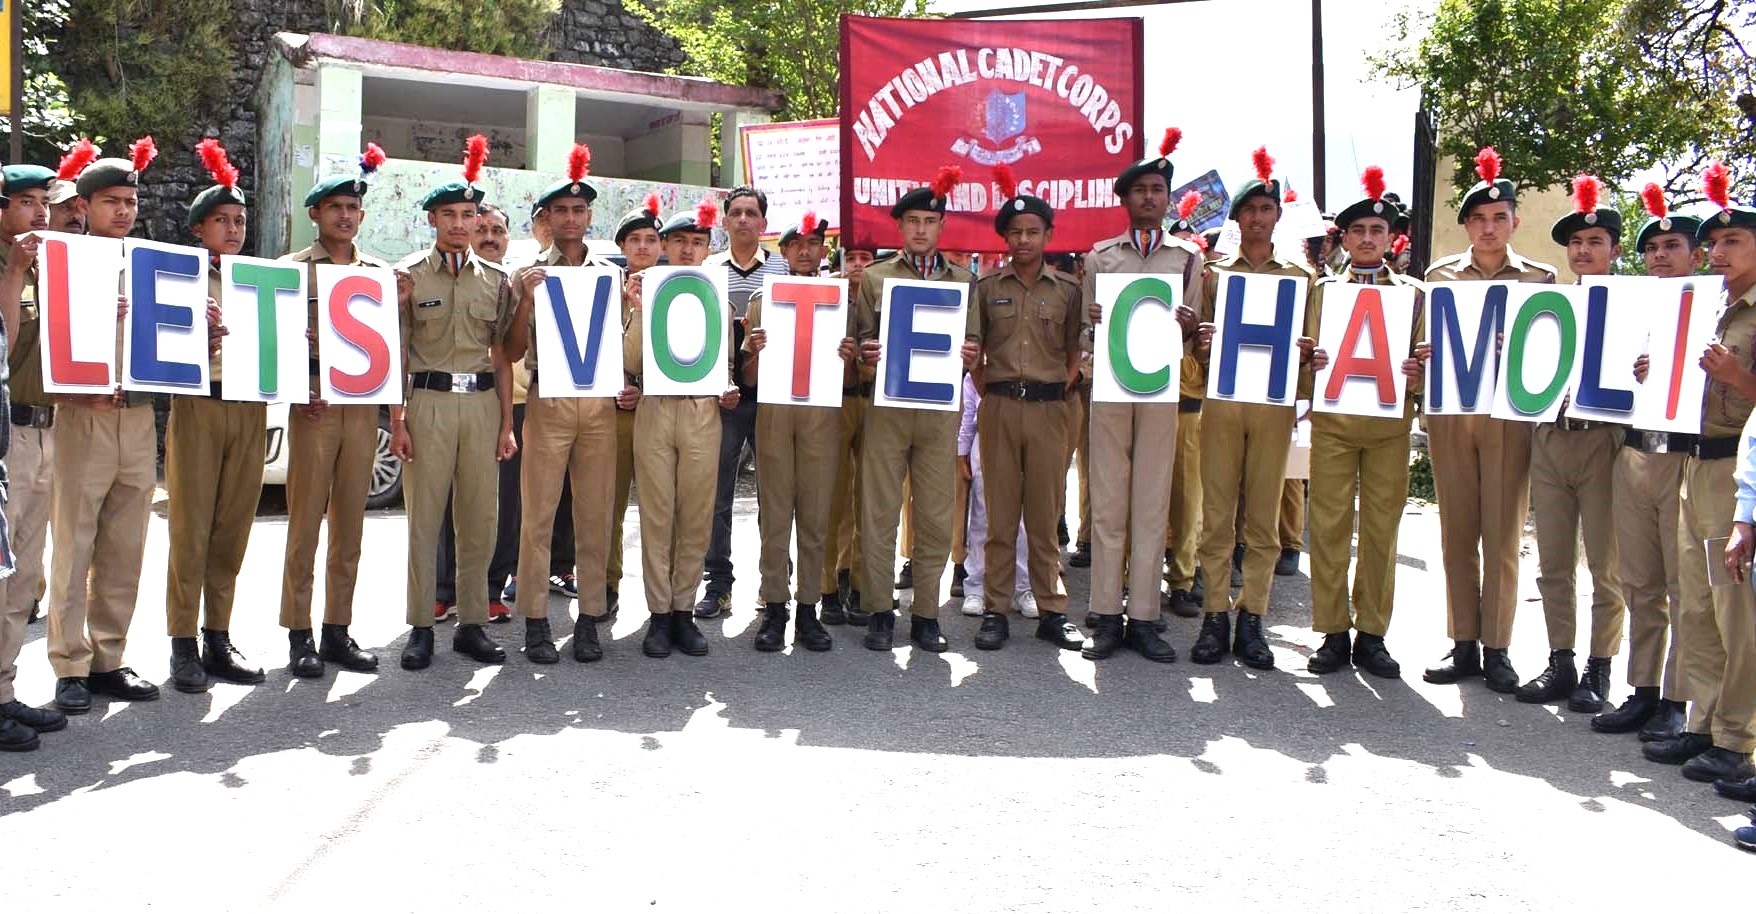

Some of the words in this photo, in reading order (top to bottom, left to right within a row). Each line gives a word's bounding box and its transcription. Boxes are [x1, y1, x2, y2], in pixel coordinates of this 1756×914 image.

[852, 48, 979, 163] NATIONAL
[977, 47, 1064, 92] CADET
[1056, 65, 1133, 155] CORPS
[991, 176, 1122, 211] DSCIPLIN
[45, 239, 391, 396] LETS
[545, 272, 964, 402] VOTE
